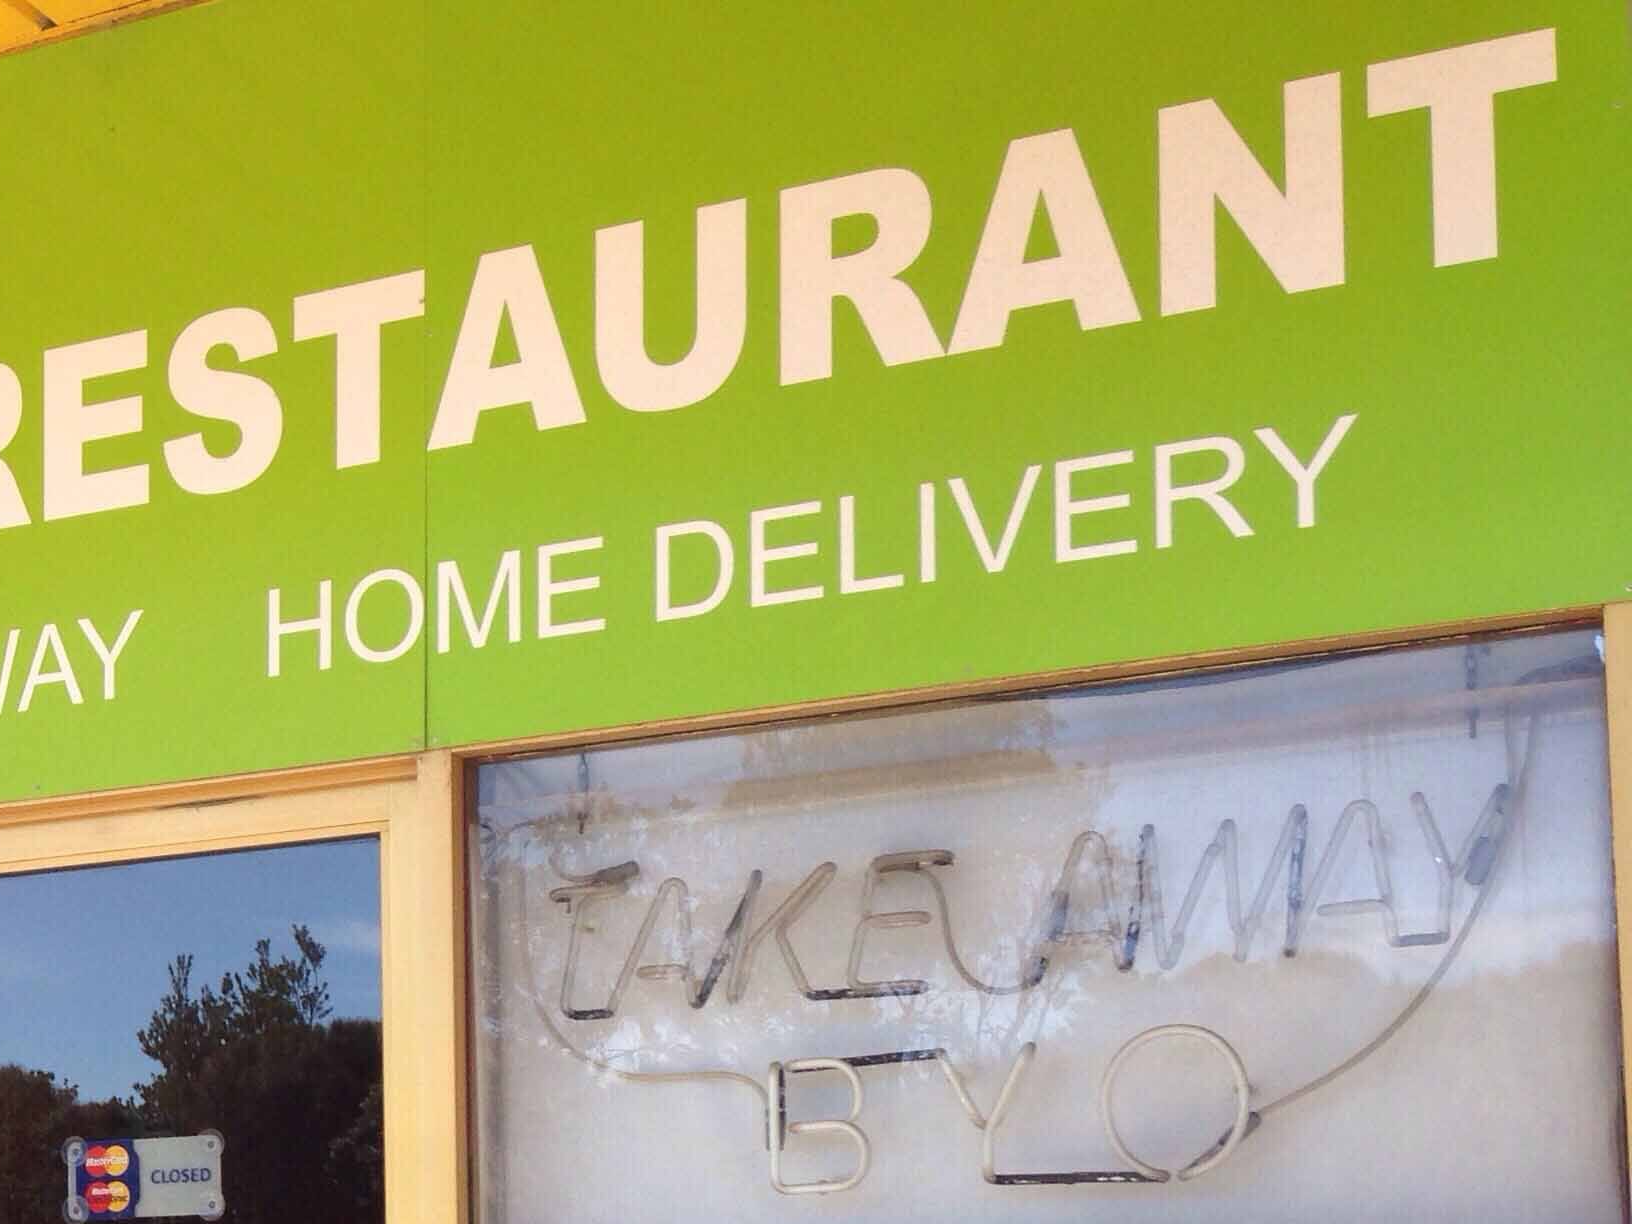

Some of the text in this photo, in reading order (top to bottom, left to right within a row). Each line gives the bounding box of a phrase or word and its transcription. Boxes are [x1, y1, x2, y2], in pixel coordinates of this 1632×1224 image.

[267, 536, 605, 678] HOME
[654, 413, 1359, 623] DELIVERY
[550, 784, 1511, 1020] TAKE AWAY
[150, 1167, 213, 1184] CLOSED
